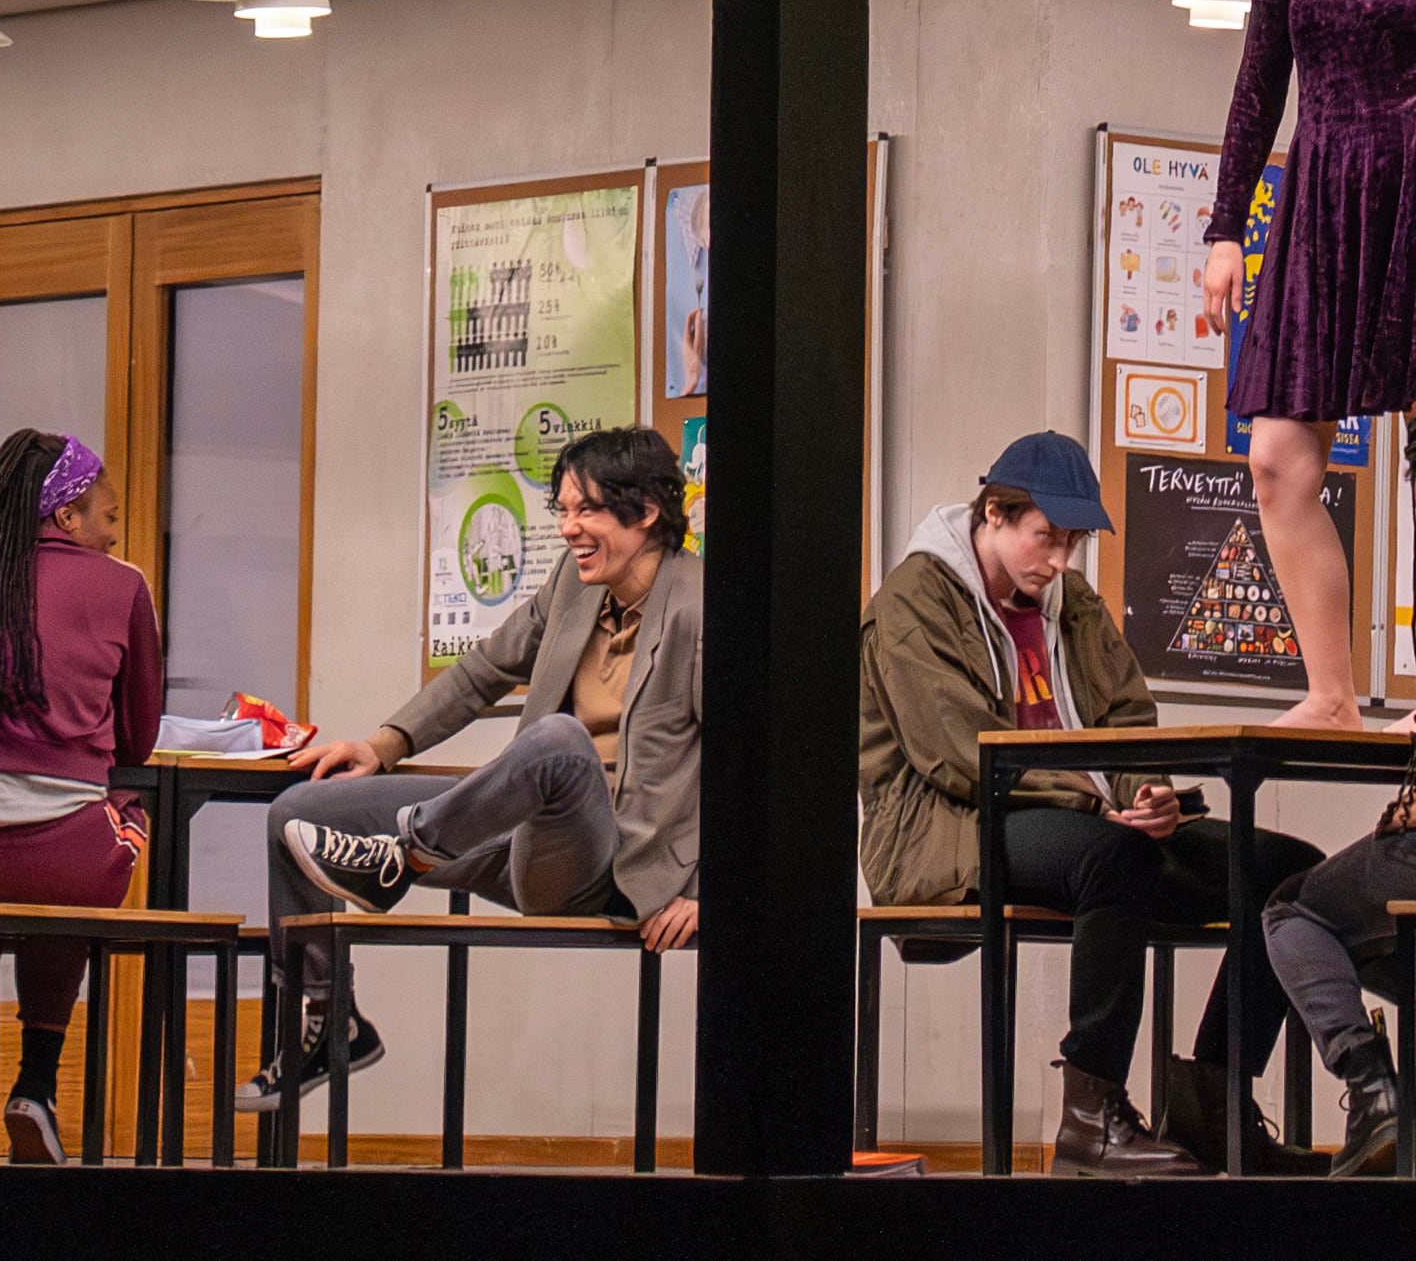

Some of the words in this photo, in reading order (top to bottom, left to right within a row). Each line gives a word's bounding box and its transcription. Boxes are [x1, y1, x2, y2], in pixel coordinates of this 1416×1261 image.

[1133, 156, 1161, 175] OLE
[1169, 159, 1209, 181] HYVÄ
[438, 406, 448, 431] 5
[538, 410, 551, 435] 5
[1140, 464, 1244, 497] TERVEYTTÄ
[432, 635, 480, 658] Kaikk
